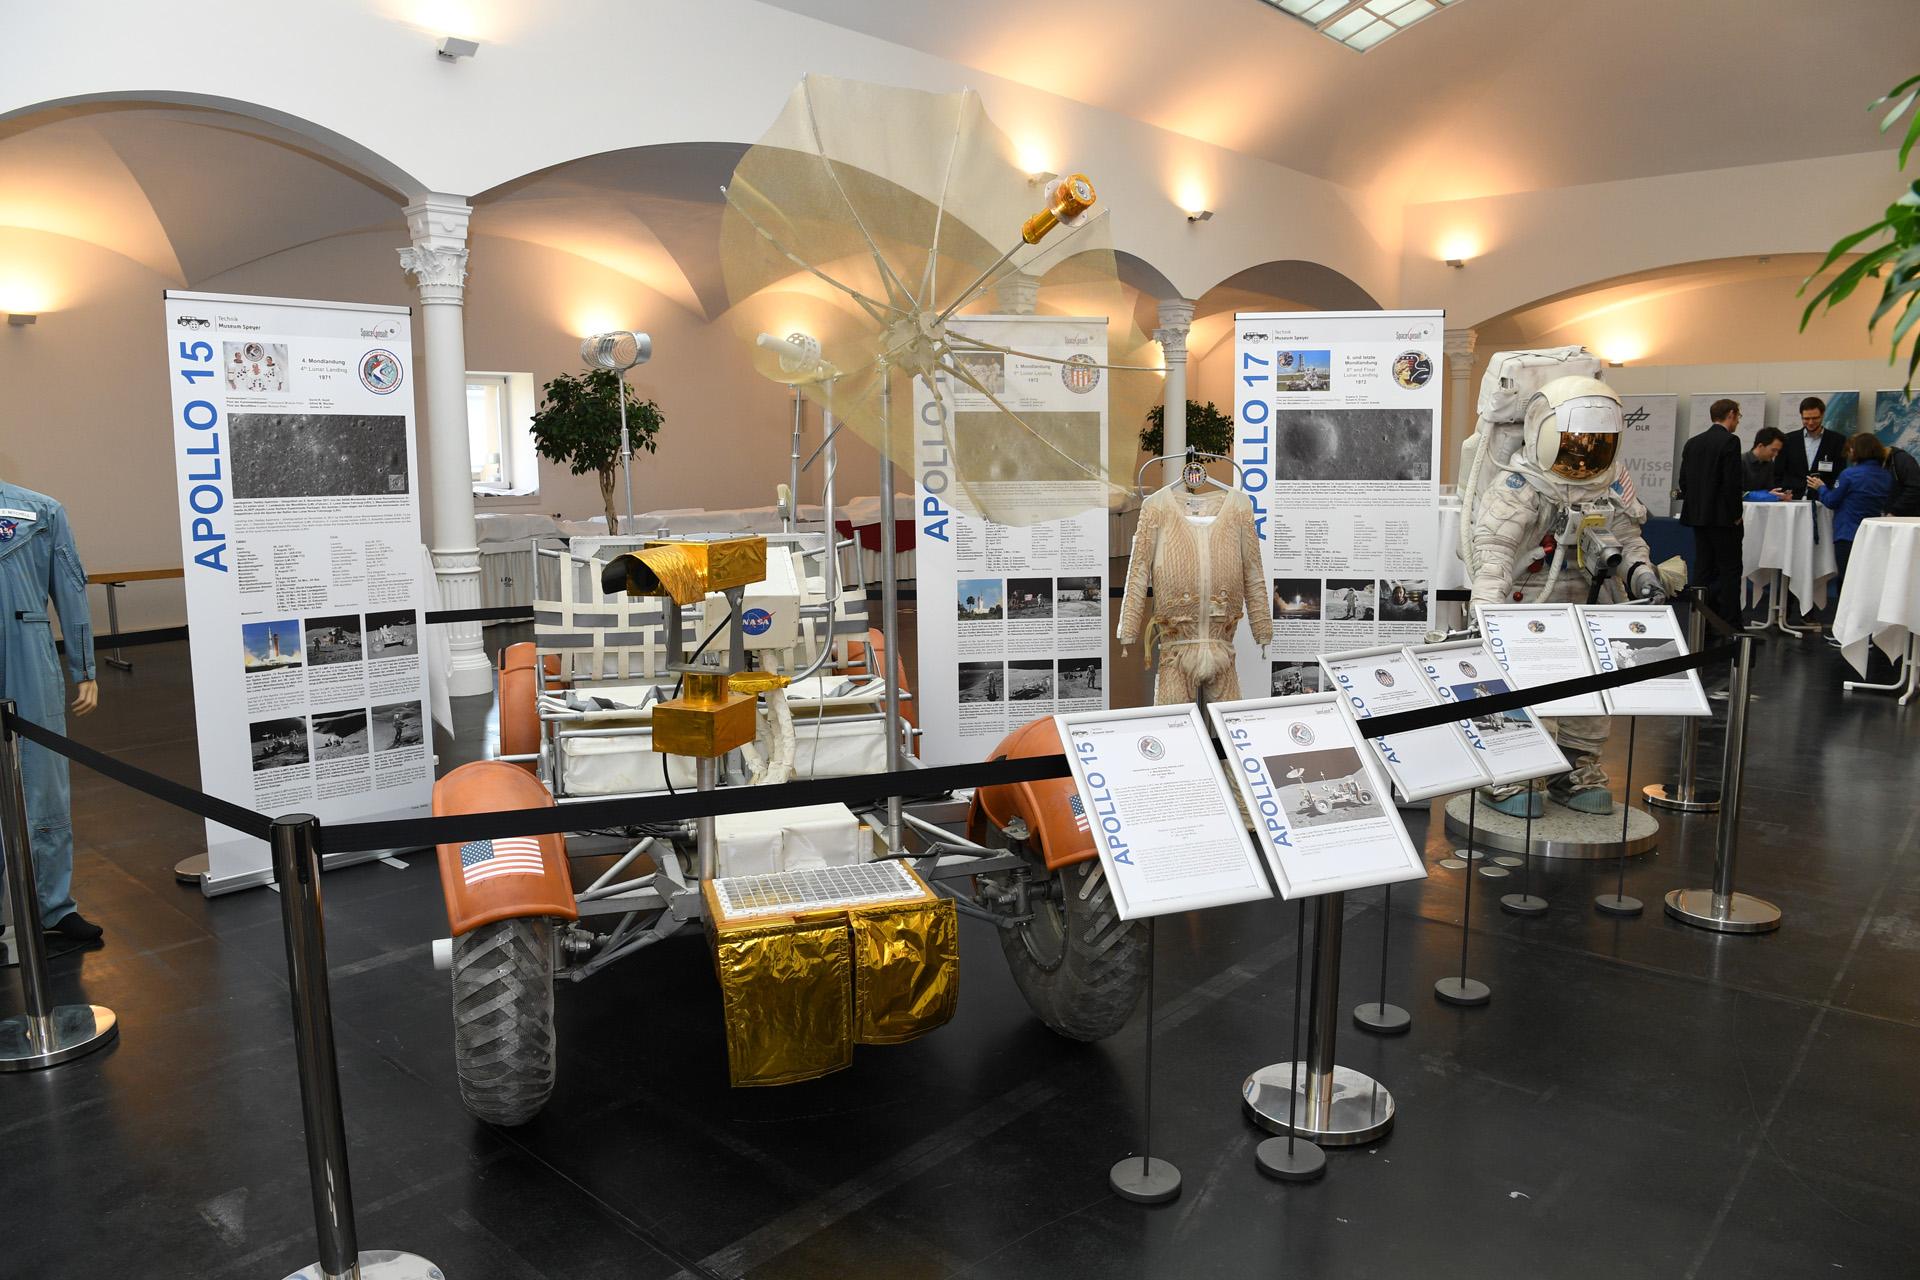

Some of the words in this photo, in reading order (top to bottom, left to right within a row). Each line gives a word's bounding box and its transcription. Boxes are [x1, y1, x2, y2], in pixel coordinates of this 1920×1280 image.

[180, 341, 215, 385] 15
[1243, 352, 1270, 387] 17
[1635, 424, 1650, 432] DLR
[1624, 457, 1673, 472] Wisse
[183, 399, 229, 573] APOLLO
[1639, 473, 1666, 487] für
[742, 618, 770, 626] NASA
[1487, 620, 1501, 634] 17
[1587, 620, 1602, 634] 17
[1491, 637, 1510, 672] OLLO
[1593, 637, 1614, 671] OLLO
[1337, 674, 1354, 692] 16
[1424, 665, 1440, 682] 16
[1230, 728, 1252, 751] 15
[1076, 741, 1098, 765] 15
[1242, 757, 1294, 848] APOLLO
[1086, 771, 1135, 867] APOLLO
